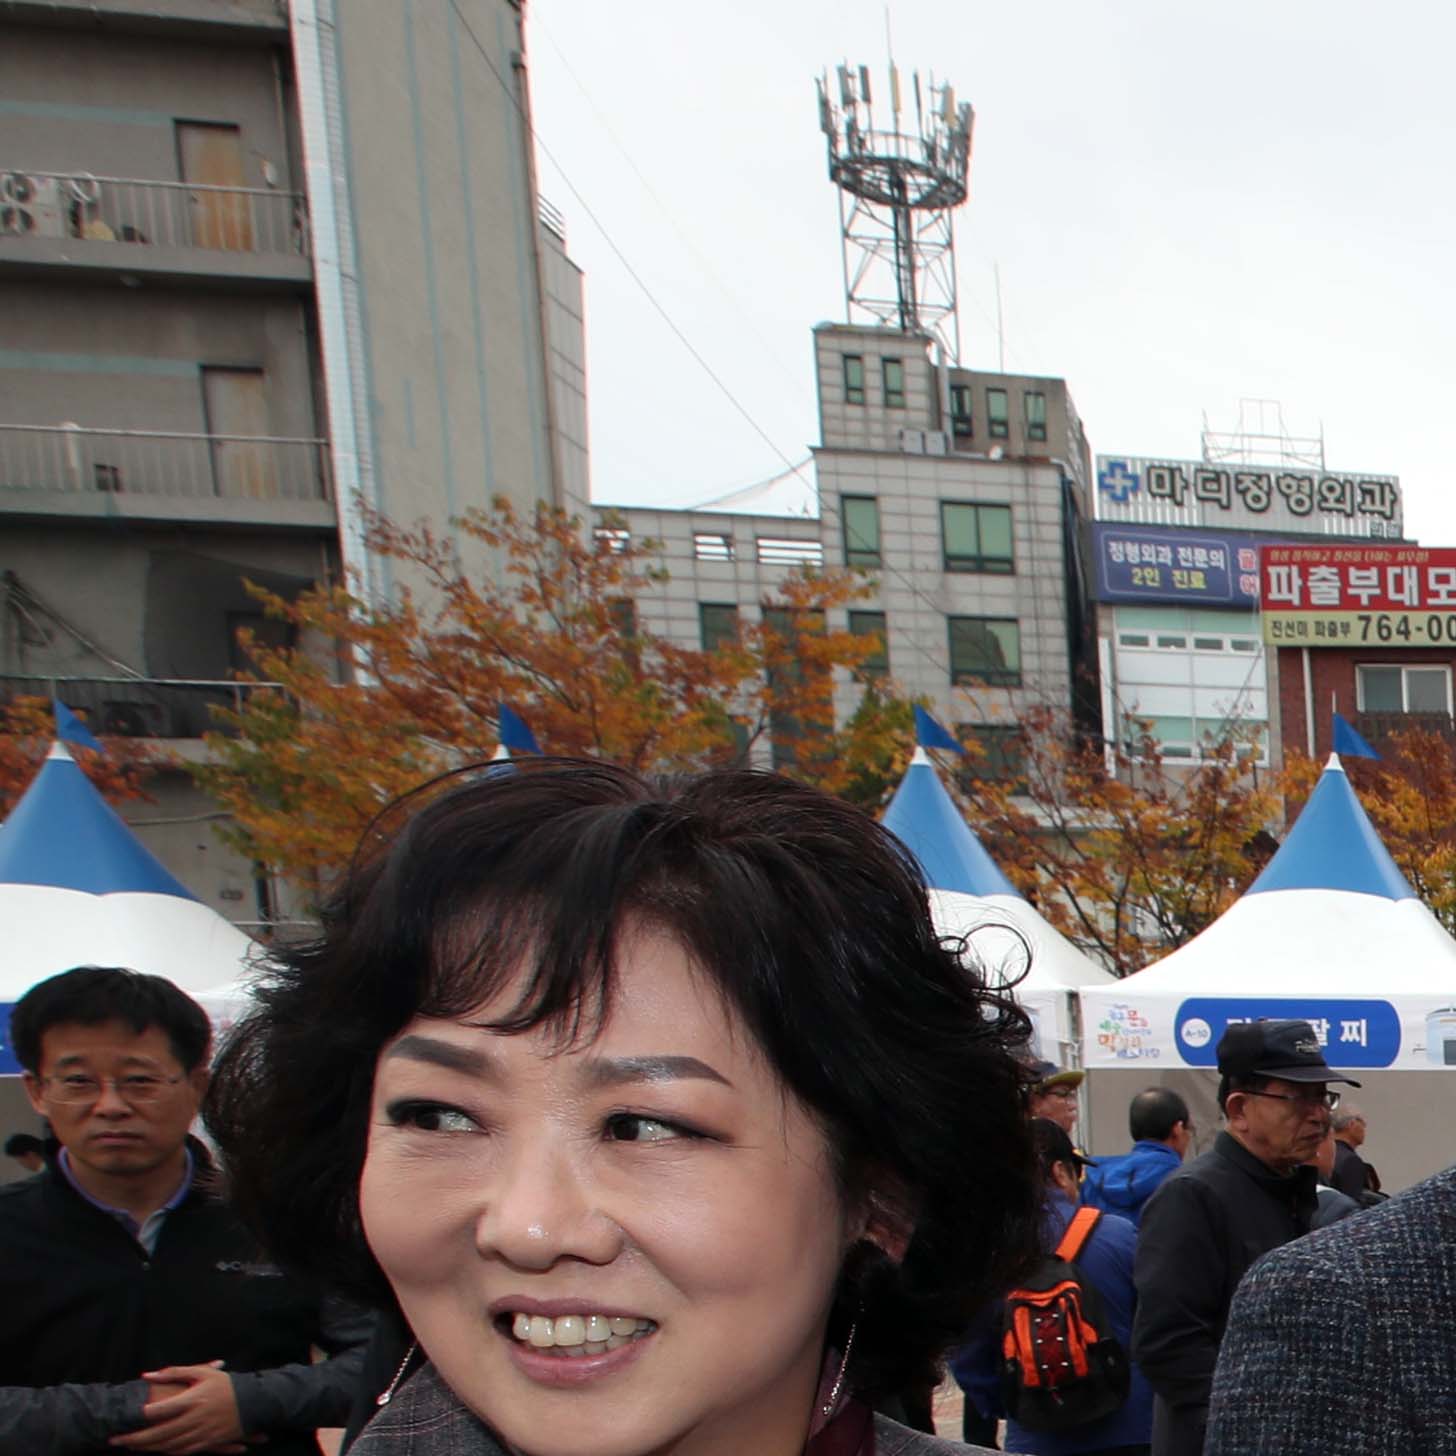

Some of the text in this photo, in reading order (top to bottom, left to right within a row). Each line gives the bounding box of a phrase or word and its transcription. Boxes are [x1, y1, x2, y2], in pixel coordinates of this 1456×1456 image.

[1146, 465, 1398, 520] 마디정형외과
[1108, 541, 1172, 566] 정형외과
[1177, 547, 1225, 570] 전문의
[1131, 567, 1206, 590] 2인 진료
[1272, 620, 1309, 639] 진선미
[1314, 621, 1350, 638] 파출부
